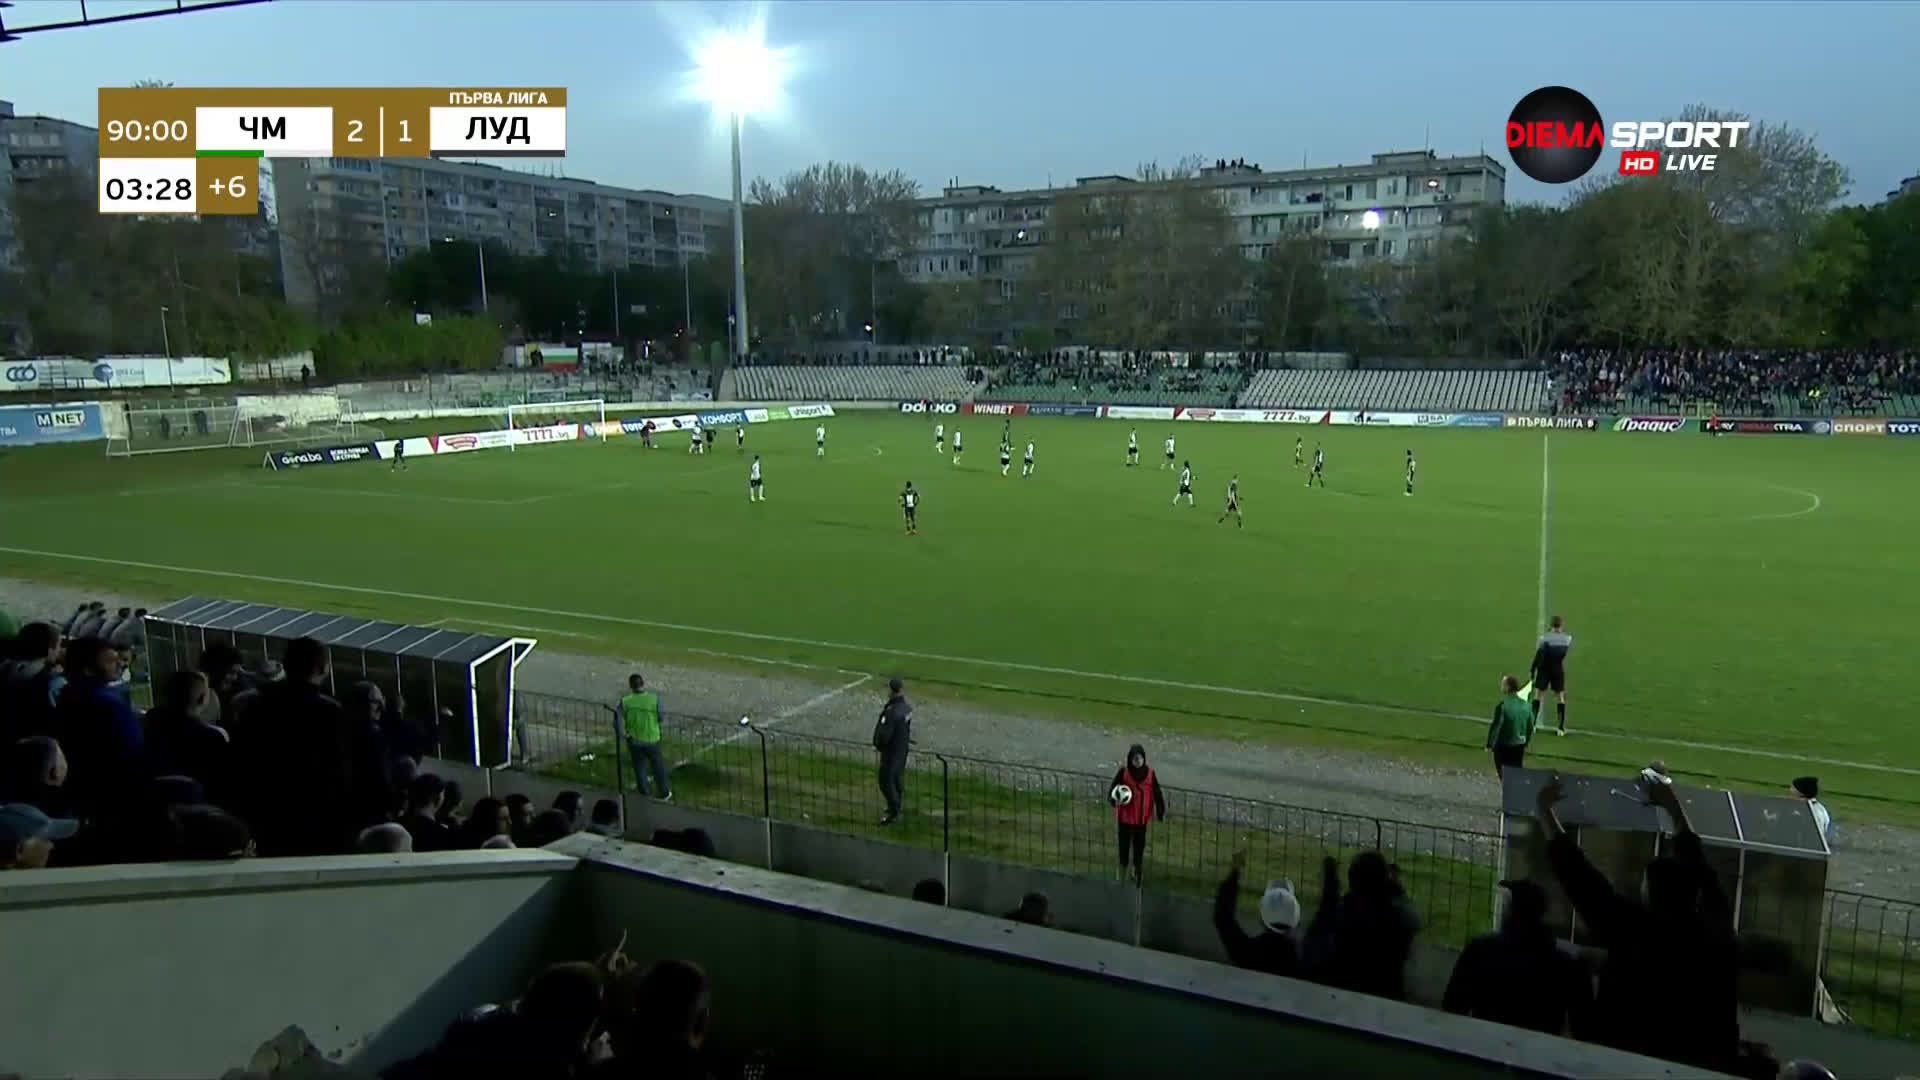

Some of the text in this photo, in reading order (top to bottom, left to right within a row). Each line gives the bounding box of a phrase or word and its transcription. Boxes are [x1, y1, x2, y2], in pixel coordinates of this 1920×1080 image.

[973, 403, 1014, 414] WINBET
[55, 412, 82, 424] NET
[1263, 411, 1310, 423] 7777.bg
[1518, 417, 1583, 428] ПЪРВА ЛИГА
[1834, 422, 1920, 433] СПОРТ ТОТ
